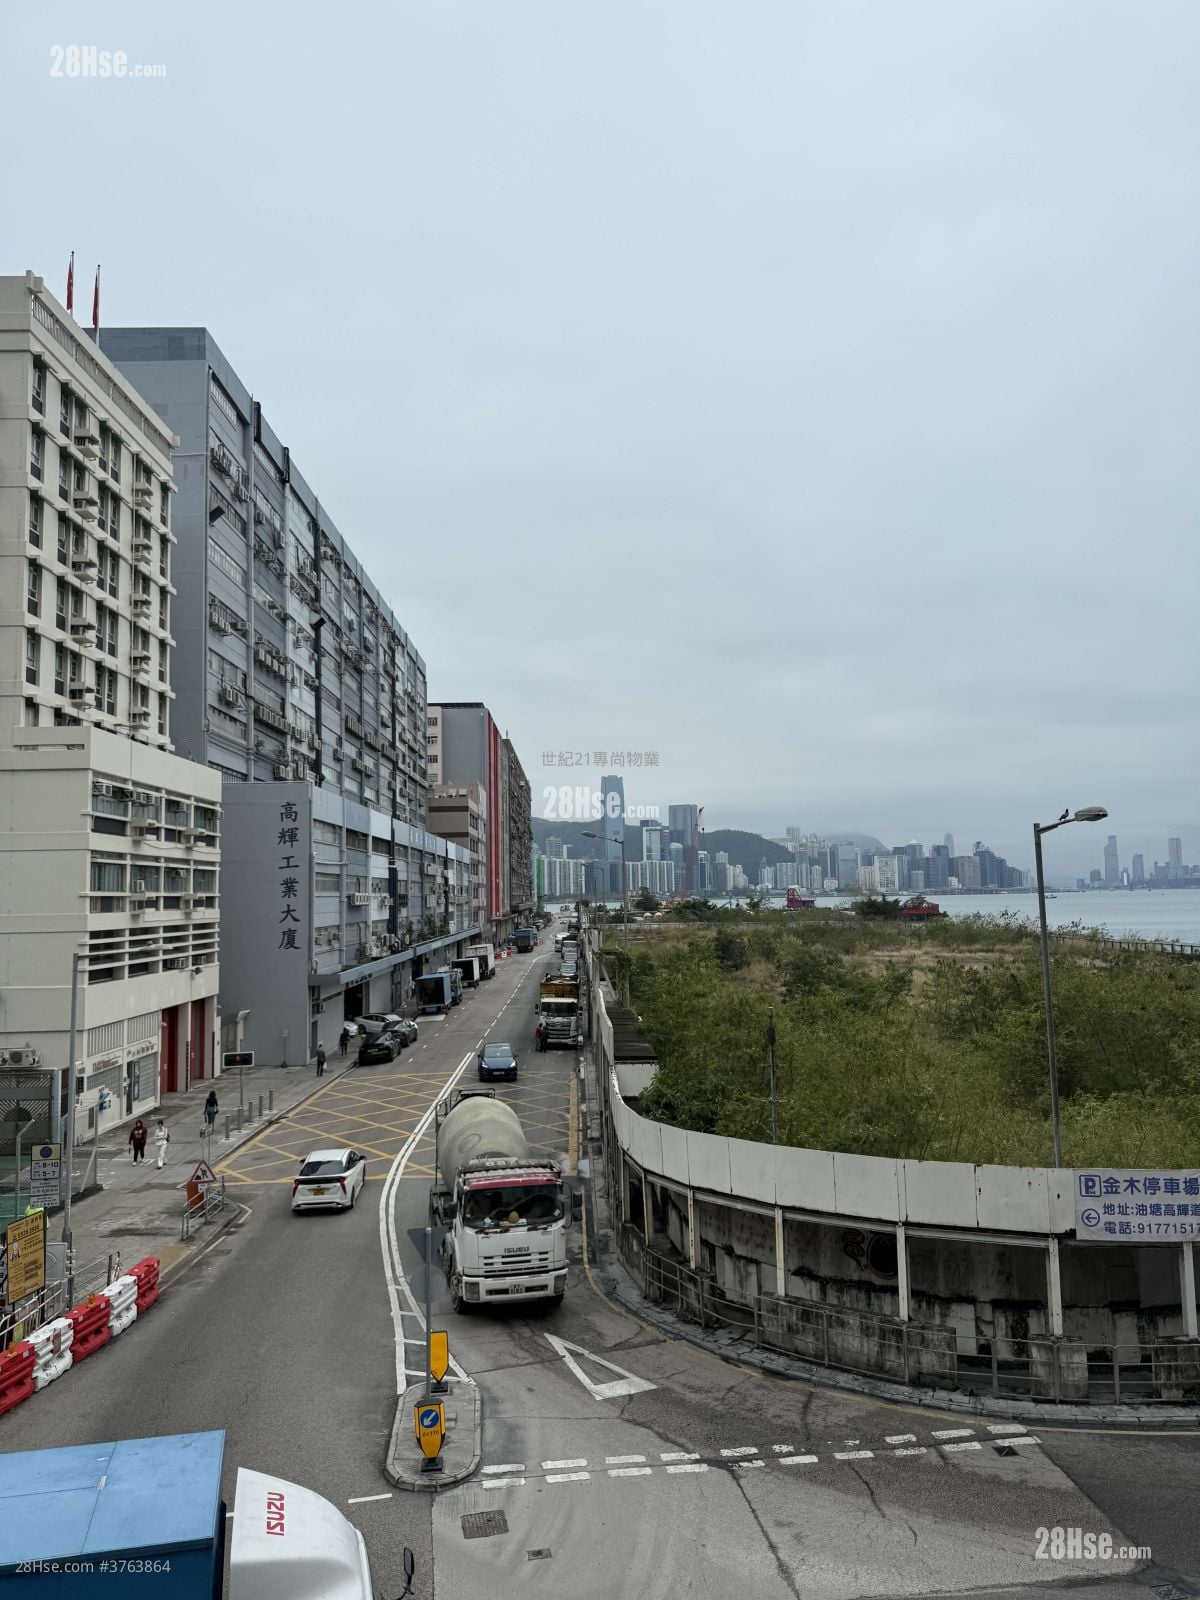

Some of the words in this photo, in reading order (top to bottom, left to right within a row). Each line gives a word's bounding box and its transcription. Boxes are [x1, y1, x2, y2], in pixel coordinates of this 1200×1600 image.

[277, 802, 301, 950] 高輝工業大廈
[1102, 1176, 1200, 1196] 金木停車場
[266, 1491, 285, 1537] ISUZU
